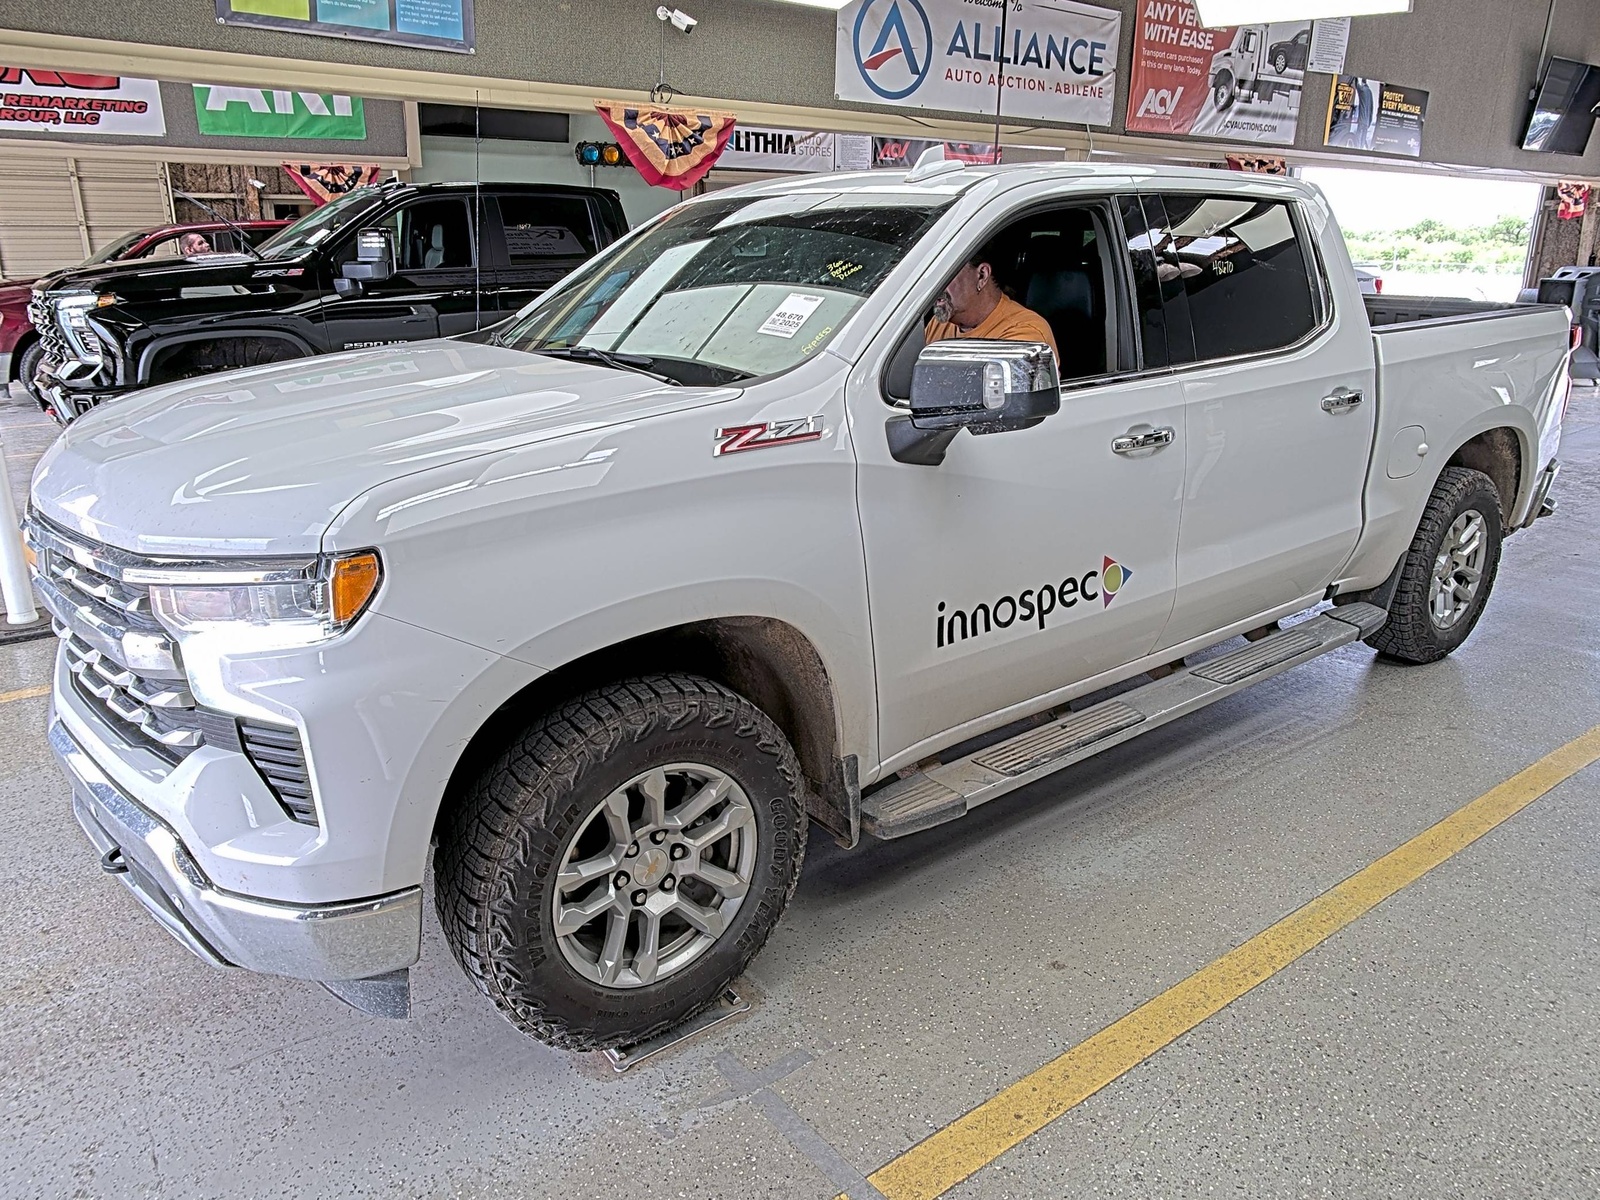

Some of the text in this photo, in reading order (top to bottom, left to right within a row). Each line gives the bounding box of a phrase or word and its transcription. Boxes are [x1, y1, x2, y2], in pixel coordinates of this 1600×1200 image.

[1144, 1, 1176, 23] ANY
[1144, 22, 1214, 51] WITH EASE.
[946, 20, 1106, 76] ALLIANCE
[1142, 47, 1166, 60] Transport
[1178, 55, 1204, 65] purchased
[1141, 58, 1147, 66] in
[1147, 59, 1157, 68] this
[1163, 64, 1172, 72] any
[1173, 64, 1186, 72] lane.
[1187, 66, 1202, 76] Today.
[945, 68, 982, 84] AUTO
[988, 74, 1045, 92] AUCTION
[1055, 82, 1103, 99] ABILENE
[4, 94, 148, 113] REMARKETING
[1136, 86, 1184, 118] ACV
[1382, 101, 1398, 111] EVERY
[1383, 91, 1404, 102] PROTECT
[0, 108, 100, 125] ROUP, LLC
[735, 130, 822, 155] LITHIA AUTO
[798, 145, 832, 157] STORES
[878, 141, 911, 160] ACV
[826, 260, 844, 272] 360
[778, 319, 801, 328] 2025
[343, 341, 384, 350] 2500
[713, 414, 824, 458] Z71
[937, 570, 1099, 648] innospec
[731, 797, 794, 956] GOODYEAR
[526, 801, 583, 972] WRANGLER
